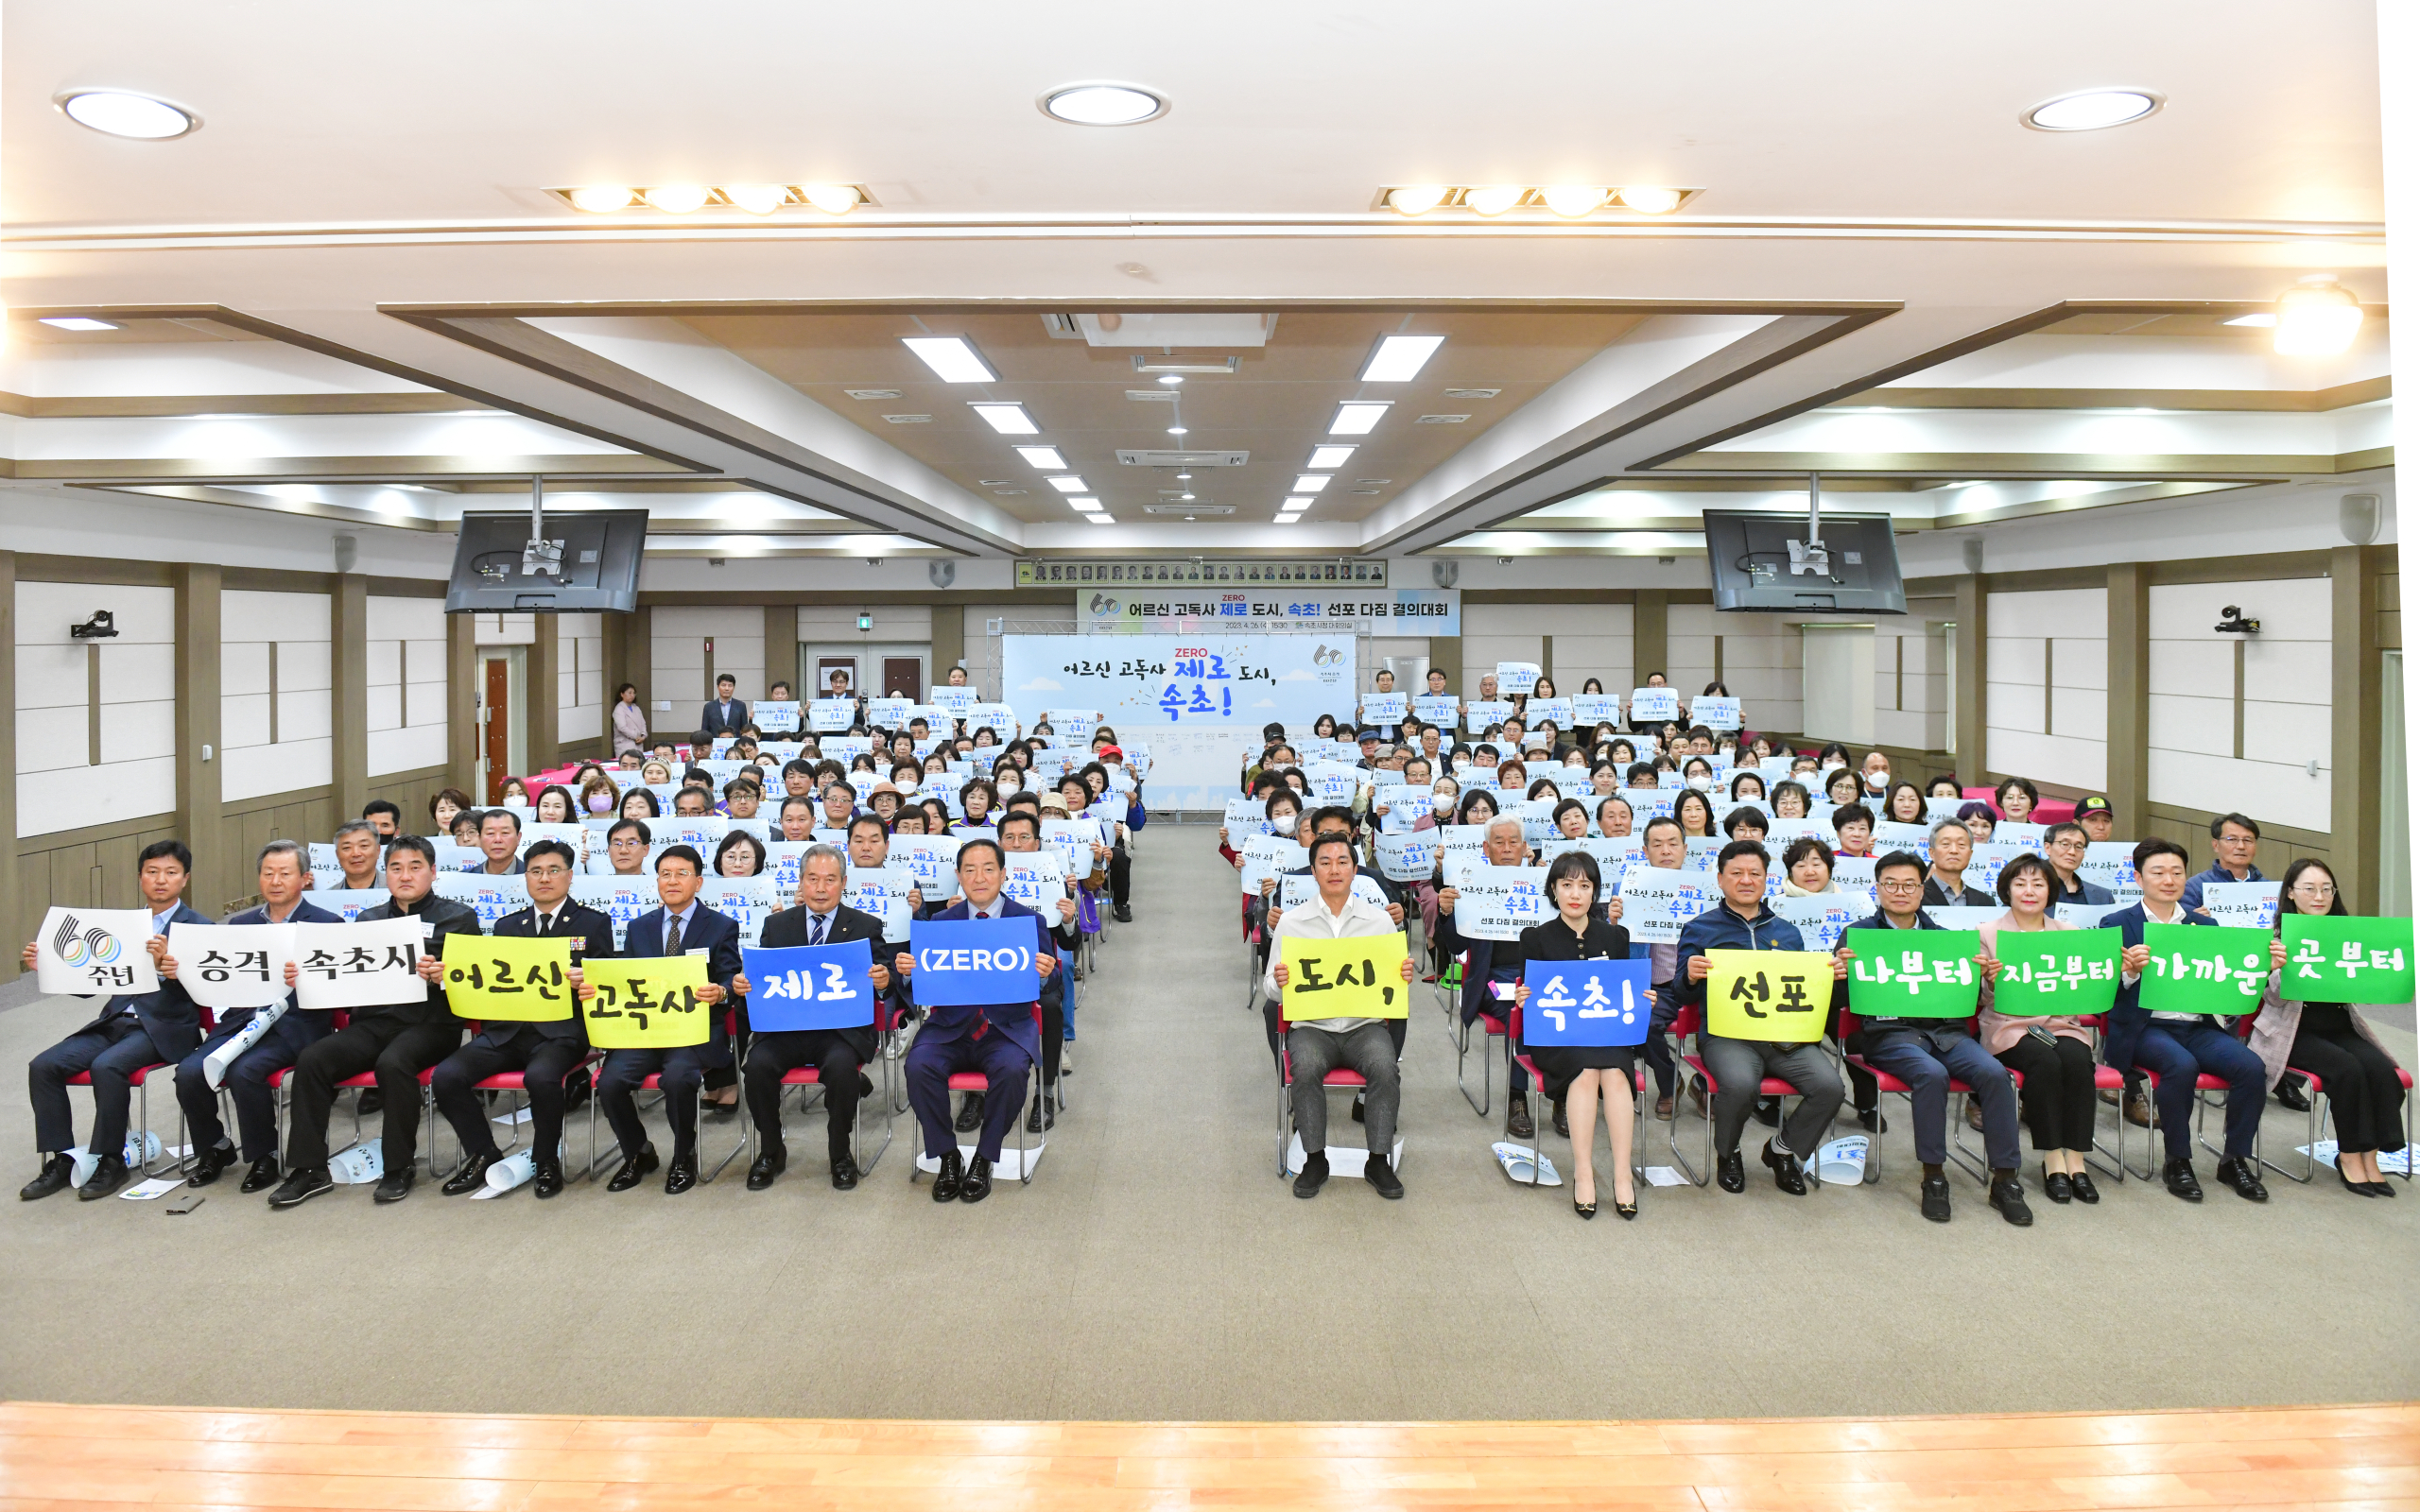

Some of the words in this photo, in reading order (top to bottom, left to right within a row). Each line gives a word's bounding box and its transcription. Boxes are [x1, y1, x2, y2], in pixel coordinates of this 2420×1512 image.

[1130, 603, 1169, 616] 어르신
[1174, 603, 1216, 616] 고독사
[1220, 603, 1247, 616] 제로
[1253, 603, 1284, 617] 도시,
[1288, 603, 1320, 616] 속초!
[1328, 603, 1356, 616] 선포
[1360, 603, 1388, 616] 다짐
[1393, 603, 1448, 616] 결의대회
[1175, 648, 1207, 657] ZERO
[1063, 661, 1110, 679] 어르신
[1119, 660, 1167, 680] 고독사
[1174, 655, 1231, 679] 제로
[1238, 666, 1276, 685] 도시,
[1159, 683, 1231, 721] 속초!
[683, 833, 705, 842] 제로
[913, 851, 936, 862] 제로
[1013, 871, 1039, 882] 제로
[478, 892, 506, 904] 제로
[510, 898, 528, 906] 도시,
[615, 893, 641, 904] 제로
[722, 896, 749, 906] 제로
[861, 885, 887, 897] 제로
[1487, 886, 1509, 896] 고독사
[1512, 885, 1539, 896] 제로
[1625, 888, 1648, 897] 어르신
[1651, 890, 1674, 900] 고독사
[1678, 889, 1704, 900] 제로
[1505, 897, 1538, 915] 속초!
[2236, 904, 2258, 913] 고독사
[1496, 918, 1510, 926] 다짐
[1512, 919, 1539, 927] 결의대회
[1800, 917, 1822, 926] 고독사
[1826, 912, 1853, 922] 제로
[199, 951, 270, 983] 승격
[302, 944, 418, 979] 속초시
[921, 946, 1030, 972] (ZERO)
[2292, 938, 2326, 977] 곳
[2336, 938, 2406, 977] 부터
[88, 963, 134, 988] 주년
[450, 959, 563, 1000] 어르신
[763, 962, 857, 1002] 제로
[1294, 958, 1395, 1005] 도시,
[1855, 951, 1973, 995] 나부터
[2003, 954, 2114, 993] 지금부터
[2152, 954, 2268, 996] 가까운
[589, 978, 700, 1031] 고독사
[1537, 975, 1635, 1032] 속초!
[1730, 971, 1815, 1019] 선포
